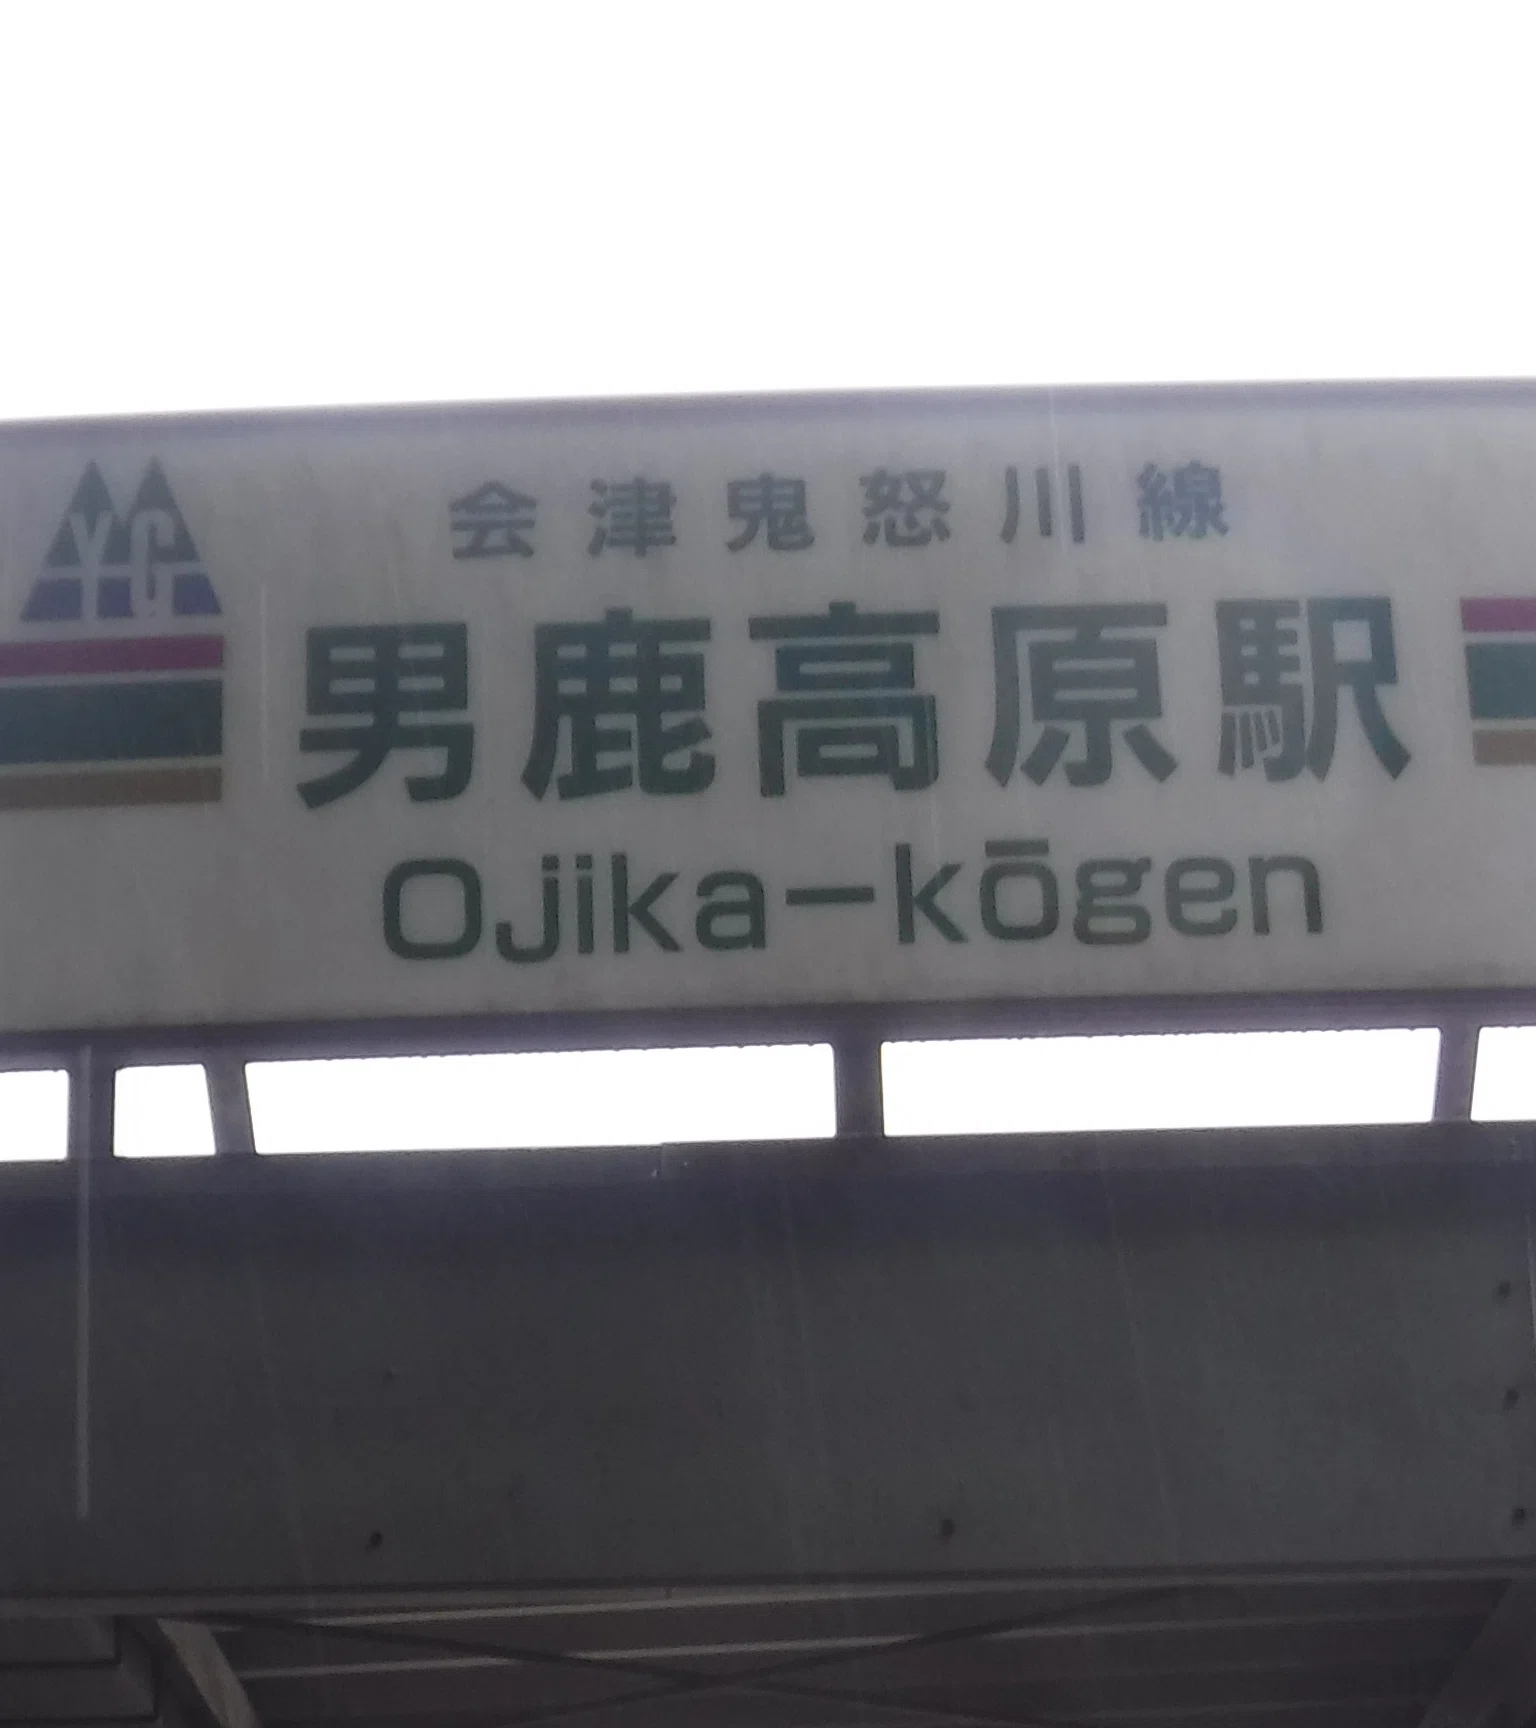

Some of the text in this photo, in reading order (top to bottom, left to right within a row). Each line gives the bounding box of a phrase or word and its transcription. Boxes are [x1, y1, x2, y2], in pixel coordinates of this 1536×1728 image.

[449, 462, 1231, 559] 会津鬼怒川線
[297, 596, 1413, 808] 男鹿高原駅
[381, 840, 1323, 965] Ojika-kōgen
